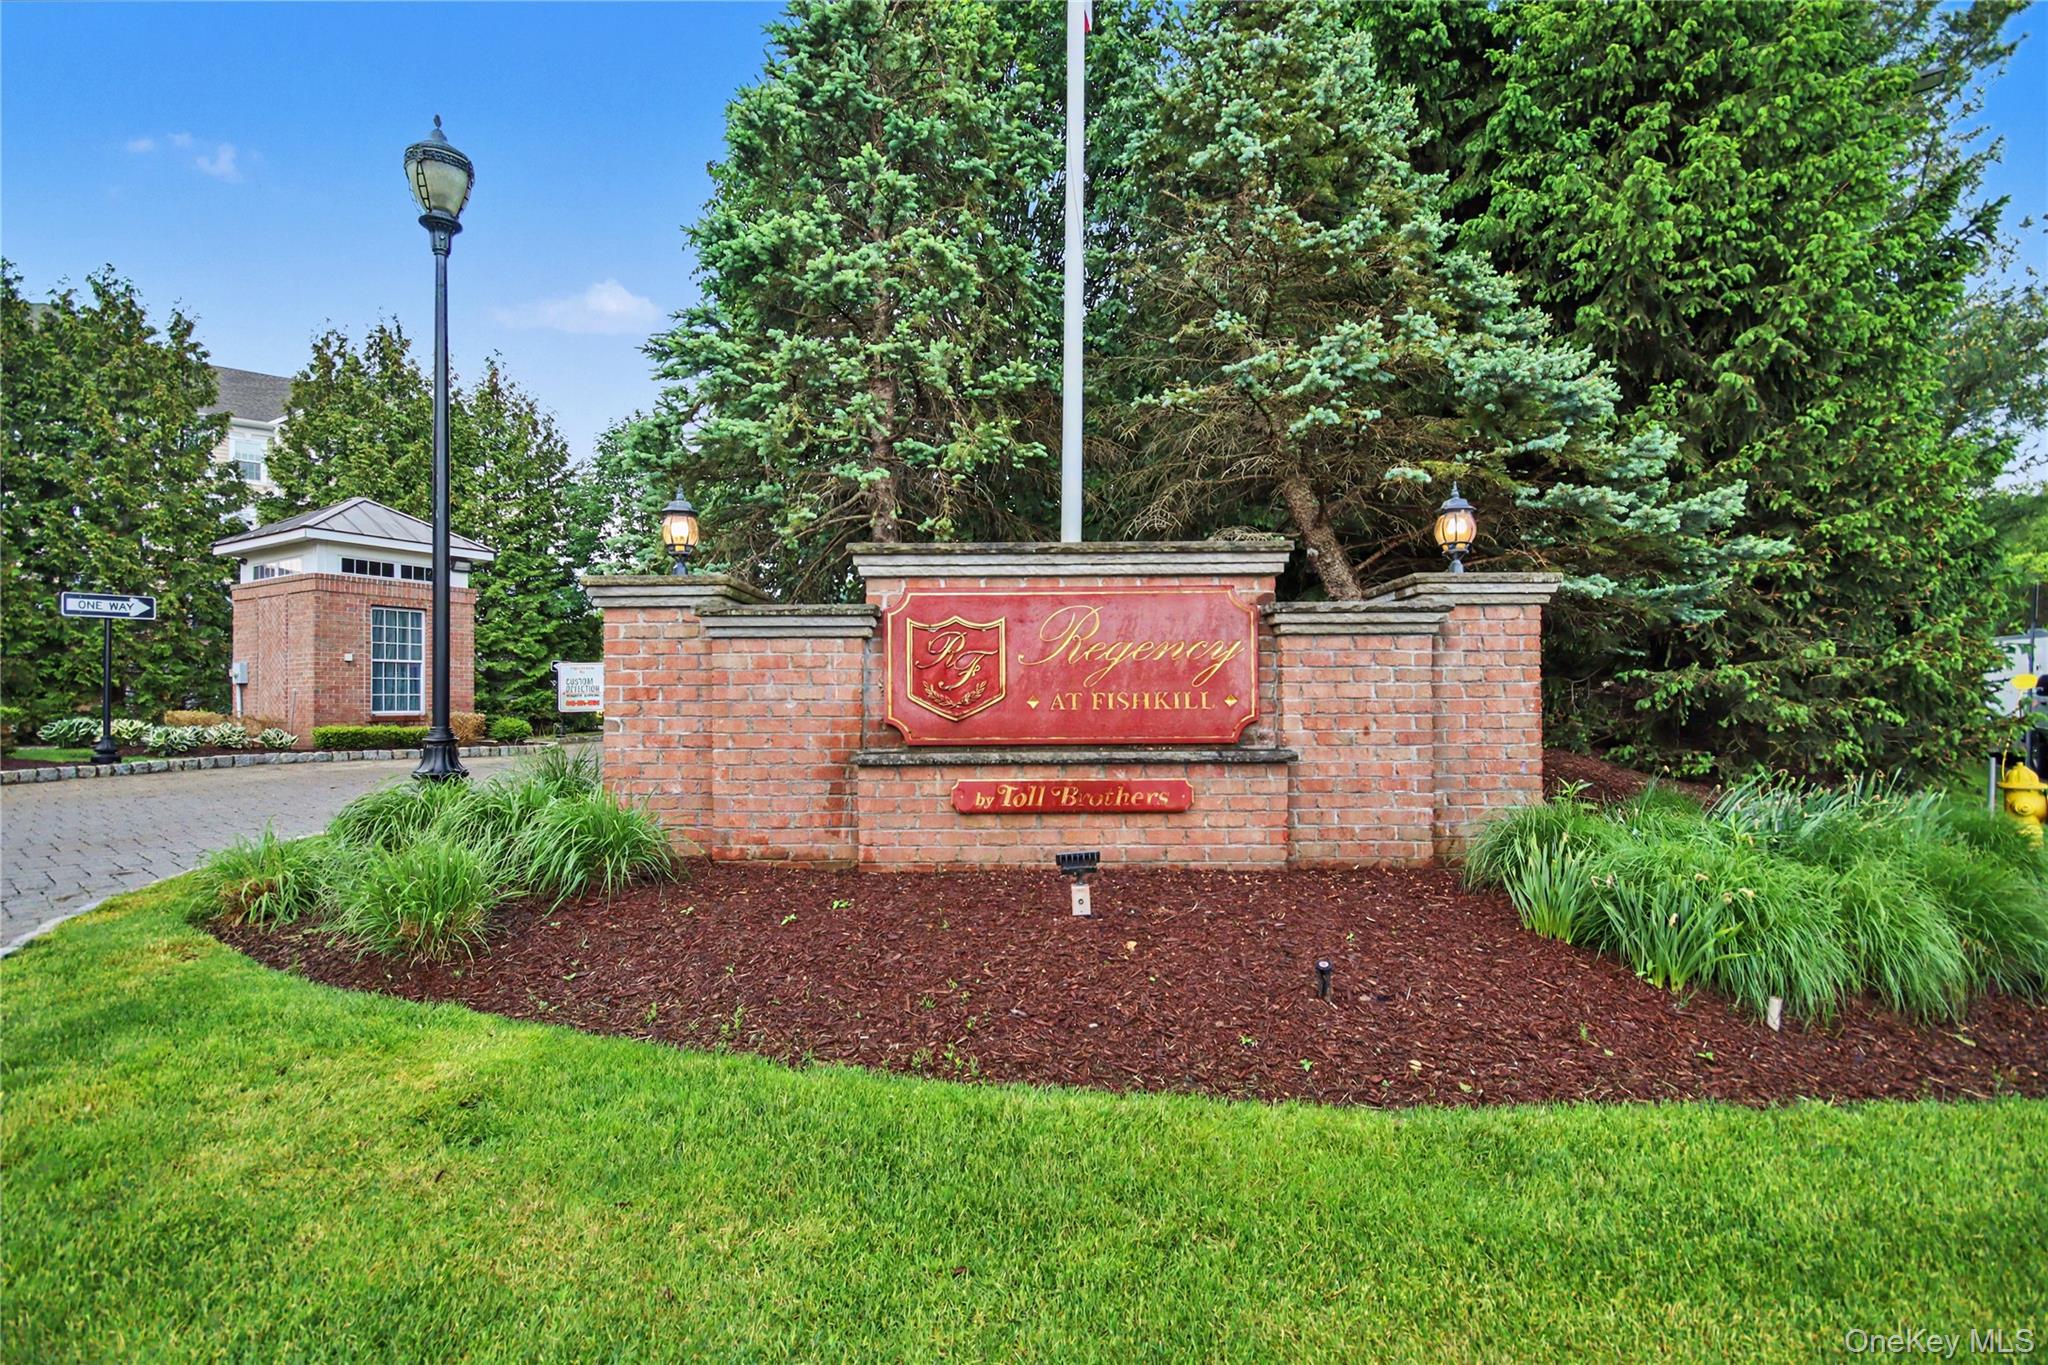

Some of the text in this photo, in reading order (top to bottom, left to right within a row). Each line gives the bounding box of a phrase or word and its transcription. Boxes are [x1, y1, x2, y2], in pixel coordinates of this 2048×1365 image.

[78, 600, 134, 611] ONE WAY
[1018, 604, 1246, 688] Regency
[1050, 691, 1216, 711] AT FISHKILL
[975, 784, 1170, 809] by Toll Brothers
